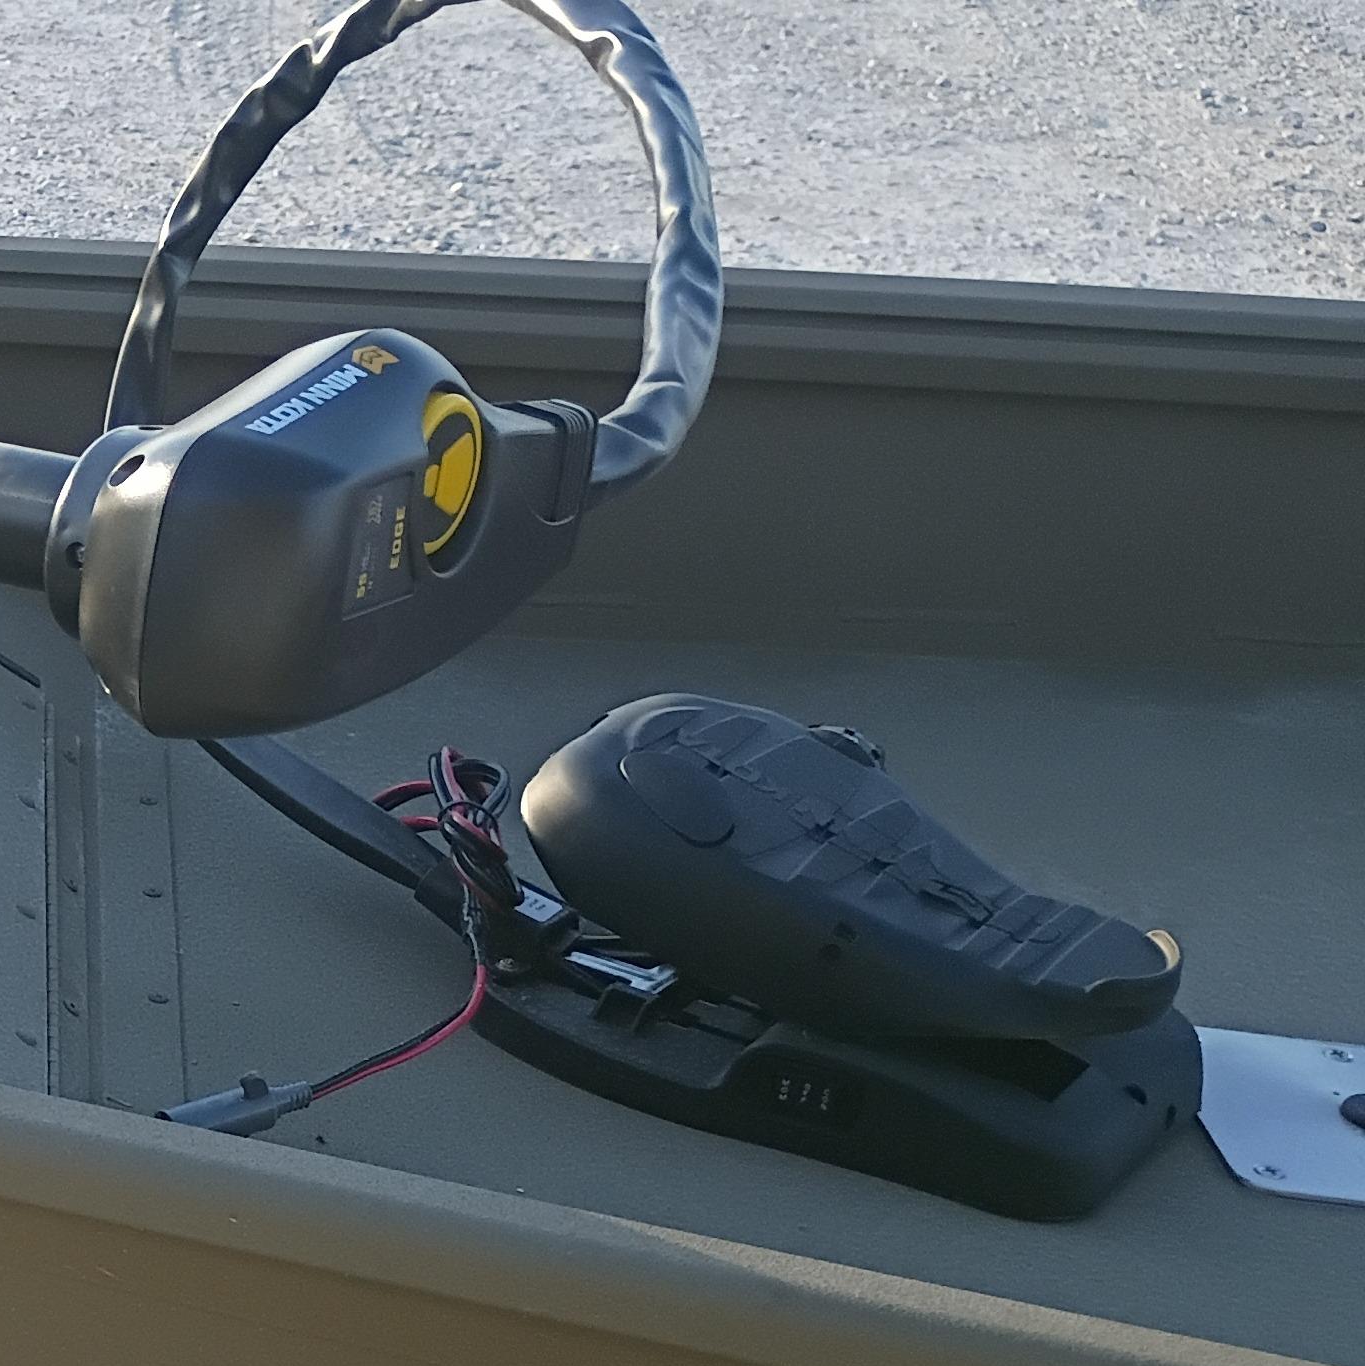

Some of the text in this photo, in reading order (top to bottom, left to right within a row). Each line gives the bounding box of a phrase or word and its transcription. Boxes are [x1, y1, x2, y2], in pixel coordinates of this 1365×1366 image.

[245, 363, 368, 435] MINN KOTA
[389, 505, 406, 570] EDGE
